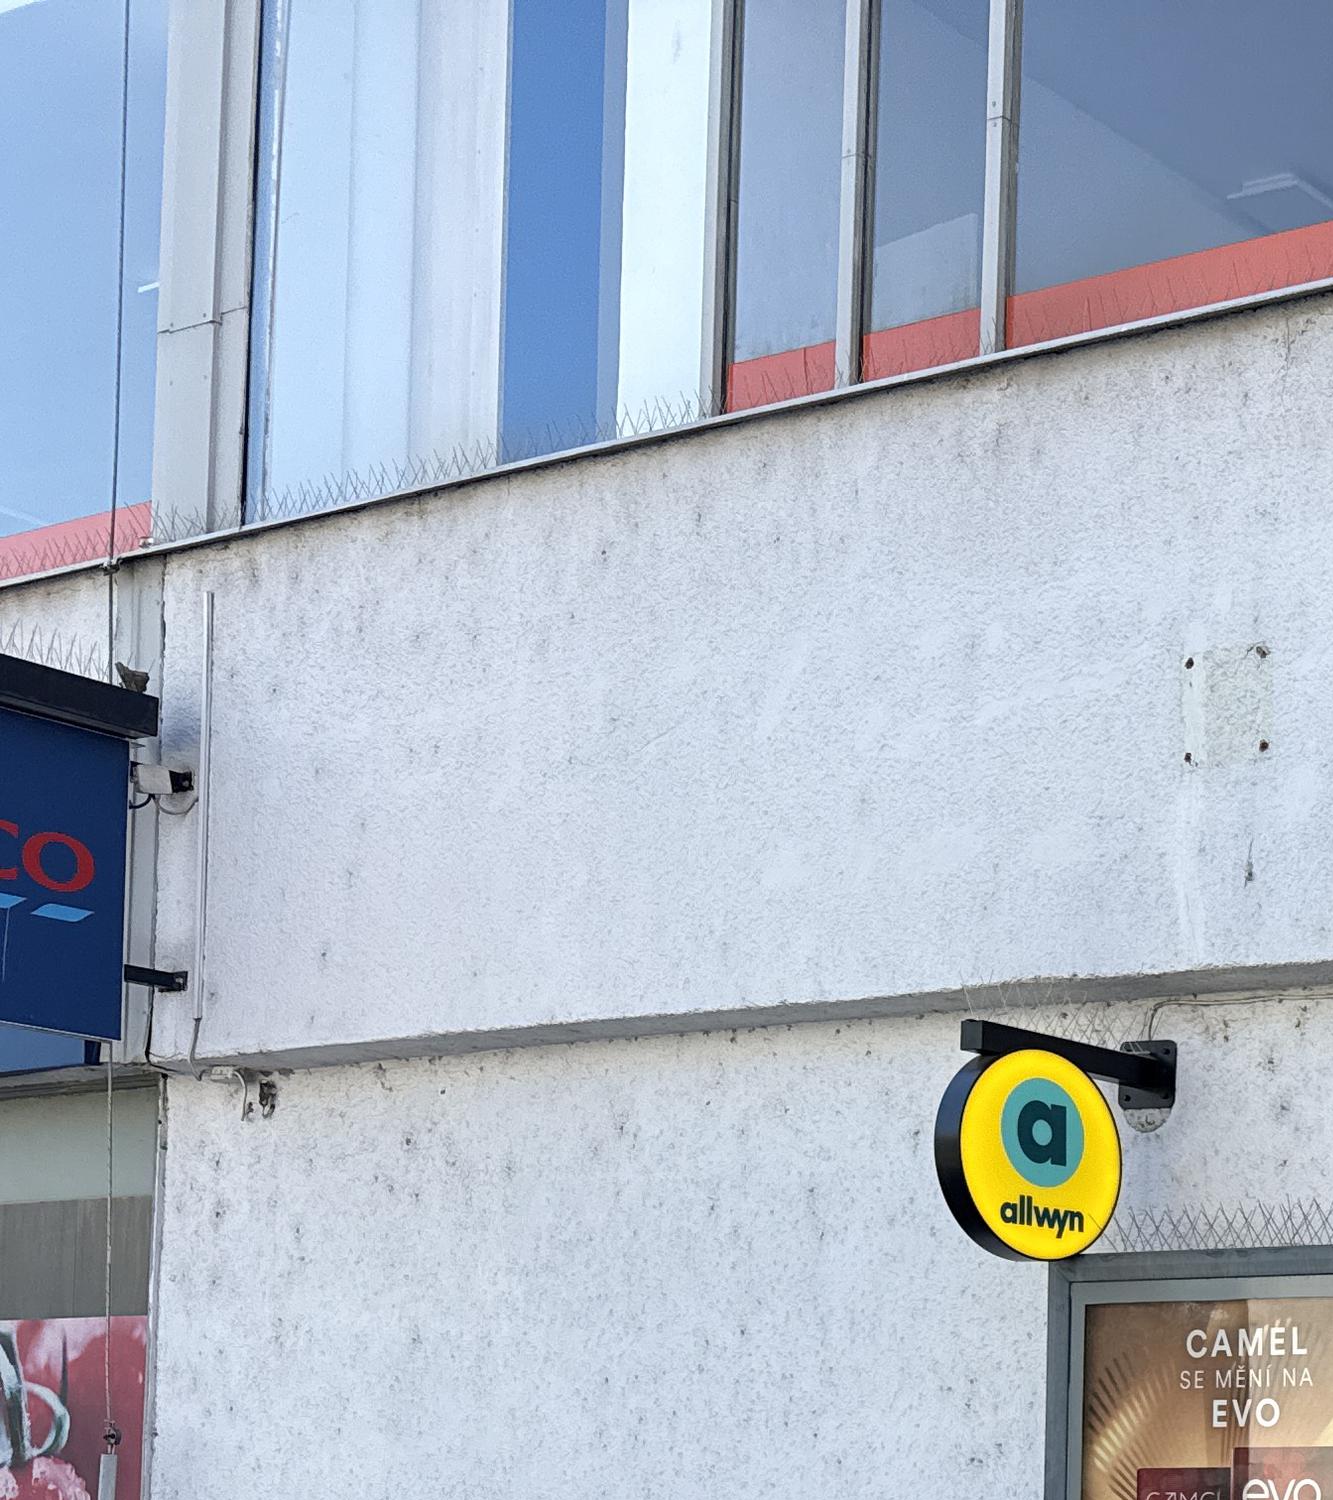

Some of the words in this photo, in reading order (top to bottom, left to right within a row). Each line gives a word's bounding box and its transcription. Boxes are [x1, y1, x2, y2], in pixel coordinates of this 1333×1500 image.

[1000, 1194, 1085, 1239] allwyn
[1185, 1326, 1308, 1358] CAMEL
[1179, 1369, 1205, 1390] SE
[1215, 1364, 1272, 1389] MĚNÍ
[1282, 1367, 1314, 1388] NA
[1212, 1397, 1280, 1428] EVO
